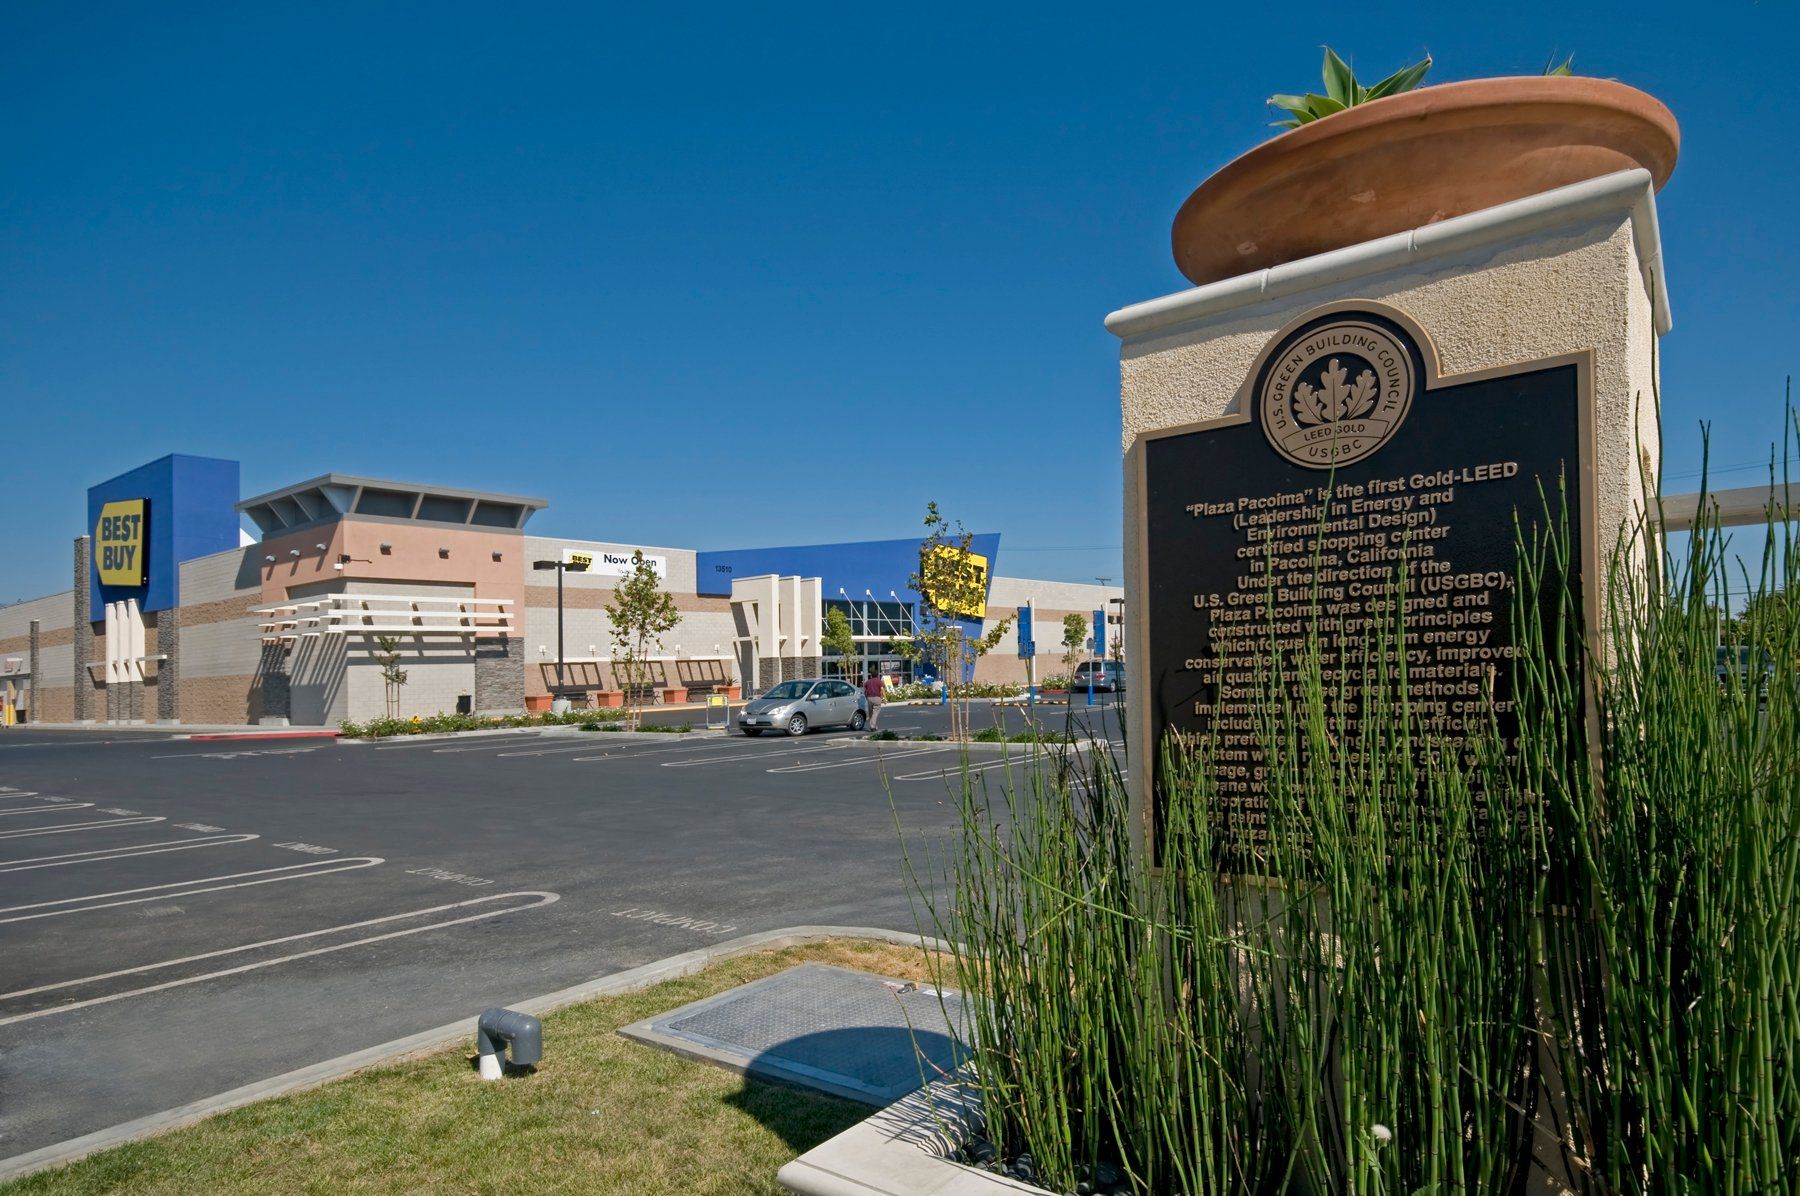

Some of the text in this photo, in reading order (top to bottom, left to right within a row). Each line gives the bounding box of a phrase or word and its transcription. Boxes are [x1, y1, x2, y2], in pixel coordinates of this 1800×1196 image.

[1272, 356, 1304, 401] GREEN
[1305, 334, 1378, 356] BUILDING
[1377, 350, 1400, 413] COUNCIL
[1304, 424, 1365, 442] LEED GOLD
[1308, 439, 1362, 458] USGBC
[1317, 487, 1333, 500] is
[1336, 483, 1364, 499] the
[1368, 477, 1406, 494] first
[1410, 461, 1518, 490] Gold-LEED
[1233, 488, 1454, 530] (Leadership in Energy and
[102, 514, 140, 541] BEST
[1247, 507, 1437, 542] Environmental Design)
[1236, 538, 1304, 559] certfied
[1391, 525, 1451, 543] center
[102, 545, 136, 571] BUY
[603, 554, 628, 565] Now
[1250, 560, 1265, 573] in
[1237, 573, 1284, 590] Under
[1287, 571, 1313, 585] the
[1316, 564, 1393, 583] direction
[1421, 559, 1451, 575] the
[1193, 593, 1224, 609] U.S.
[1227, 592, 1273, 606] Green
[1277, 584, 1345, 602] Building
[1210, 591, 1489, 622] Plaza Pacoima was desgned and
[1208, 619, 1302, 638] constructed
[1305, 617, 1341, 633] with
[1345, 614, 1395, 634] green
[1308, 635, 1328, 649] n
[1332, 631, 1419, 650] long-erm
[1423, 628, 1491, 645] energy
[1185, 653, 1287, 670] conservatio,
[1290, 652, 1337, 666] waer
[1341, 648, 1432, 665] effcecy,
[1203, 670, 1222, 684] air
[1283, 668, 1308, 682] an
[1319, 663, 1402, 684] ecyclale
[1409, 662, 1503, 680] materials.
[1221, 685, 1264, 699] Some
[1293, 684, 1338, 698] thse
[1366, 698, 1448, 717] hpping
[1452, 698, 1515, 713] cener
[1423, 714, 1497, 731] efficien
[1225, 731, 1294, 748] prefere
